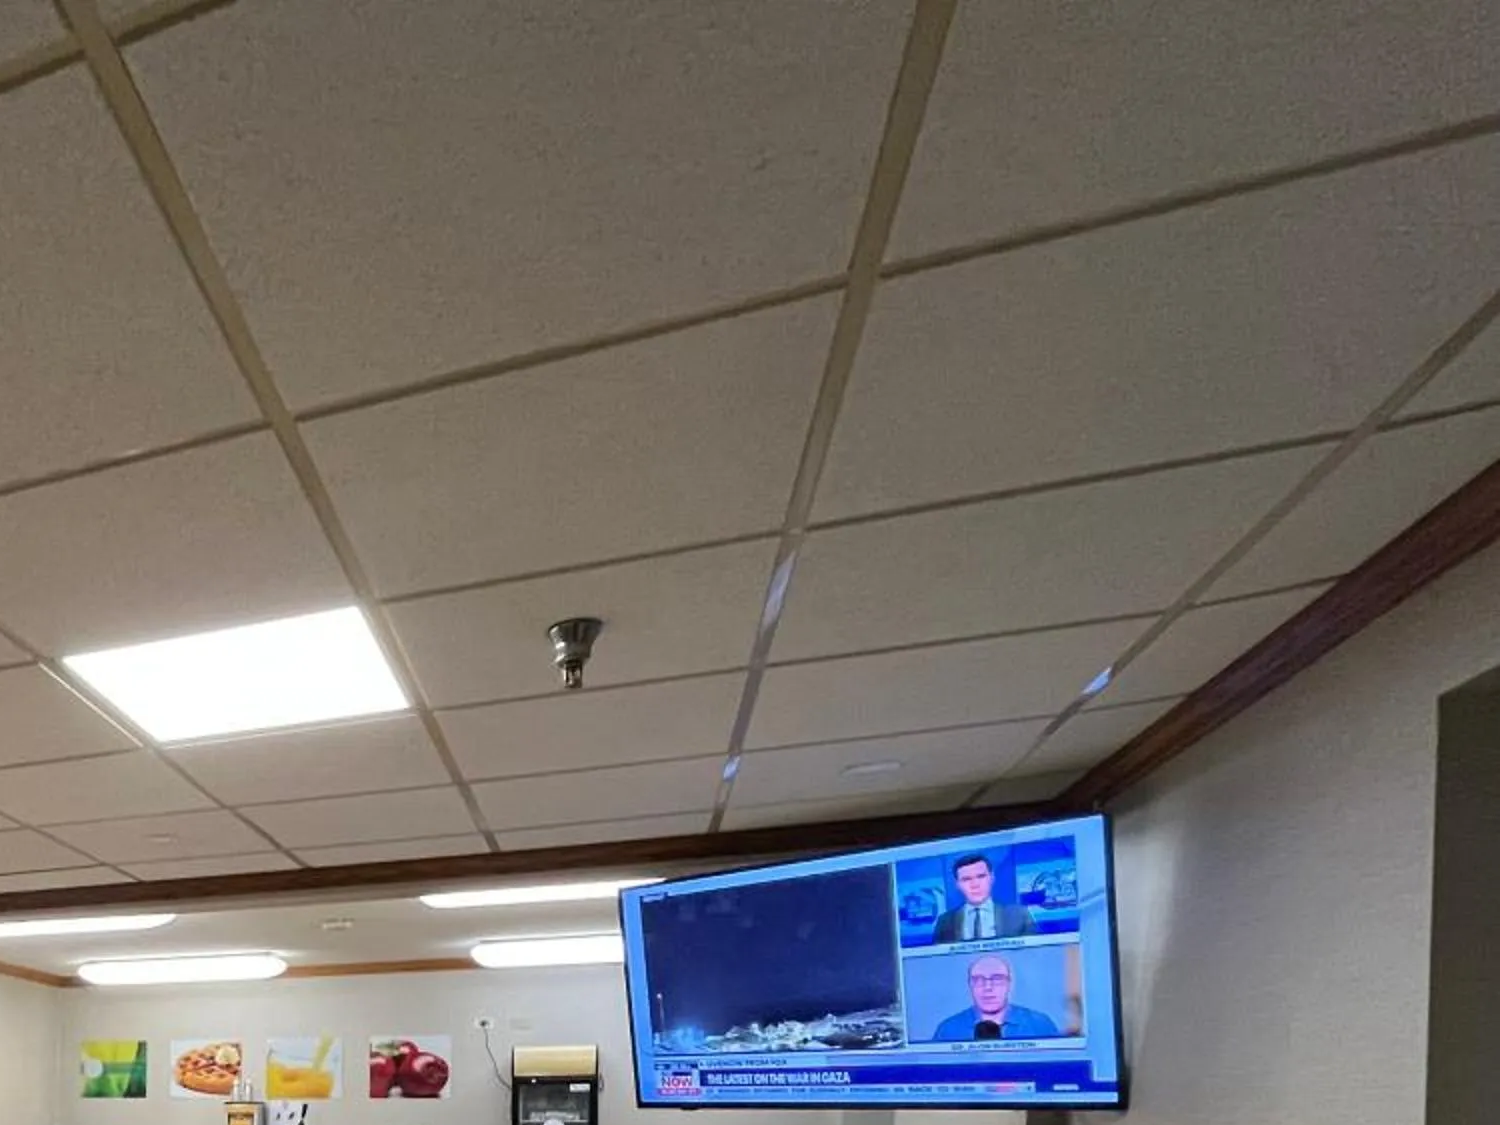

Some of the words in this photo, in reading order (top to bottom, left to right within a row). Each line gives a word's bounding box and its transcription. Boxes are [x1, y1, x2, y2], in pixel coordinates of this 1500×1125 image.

[723, 1073, 753, 1085] LATEST
[787, 1072, 808, 1083] WAR
[822, 1071, 851, 1083] GAZA
